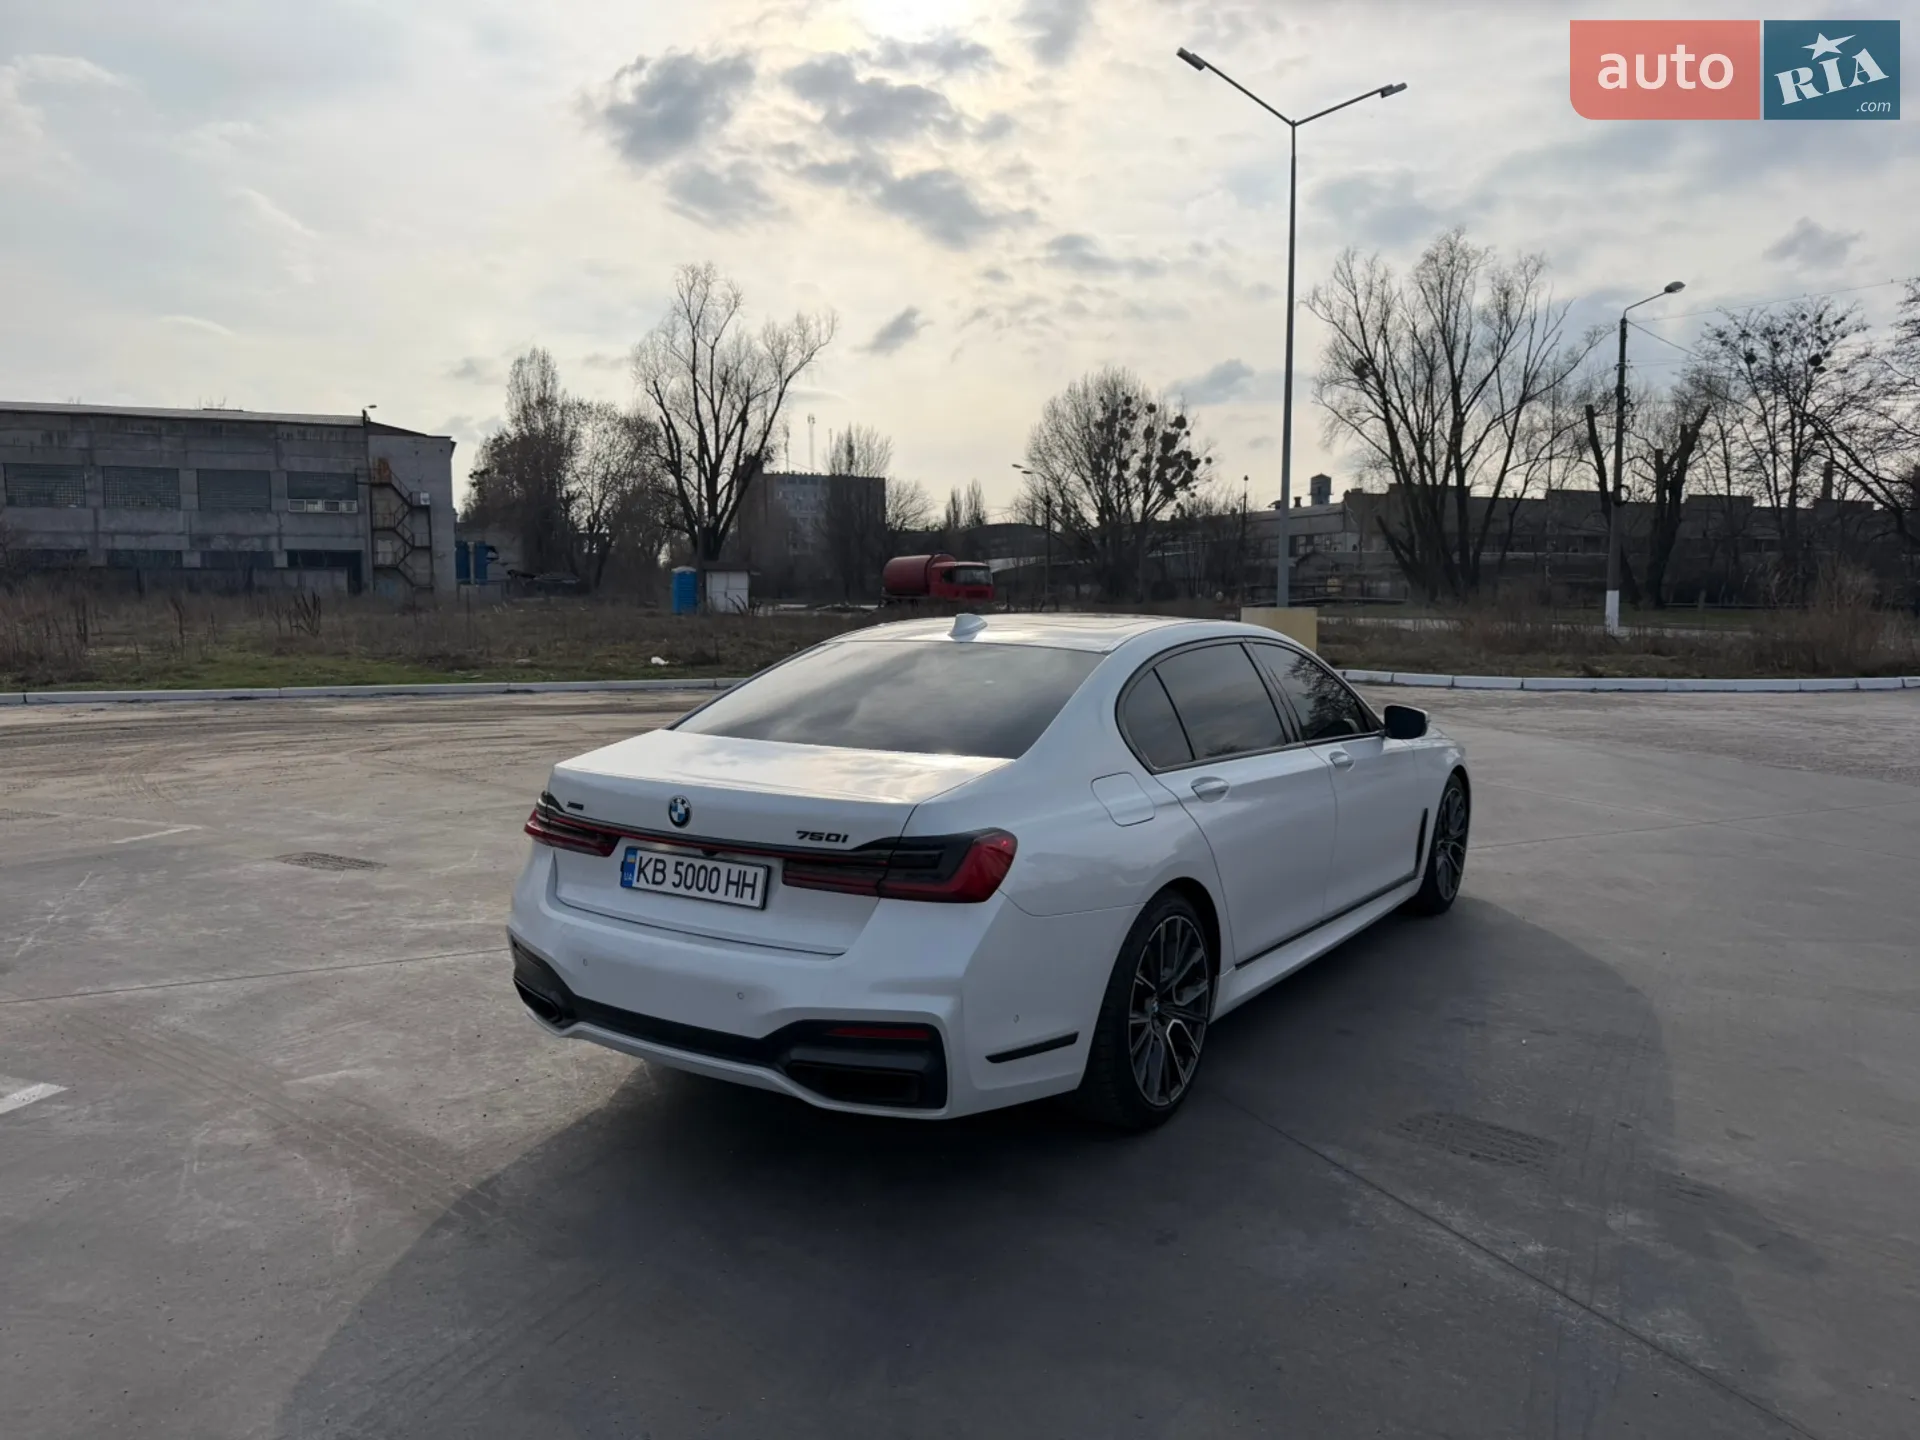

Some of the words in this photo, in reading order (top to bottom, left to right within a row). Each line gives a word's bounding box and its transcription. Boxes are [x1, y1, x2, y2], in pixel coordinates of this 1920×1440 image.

[636, 855, 667, 886] KB
[671, 861, 721, 894] 5000
[724, 868, 758, 900] HH
